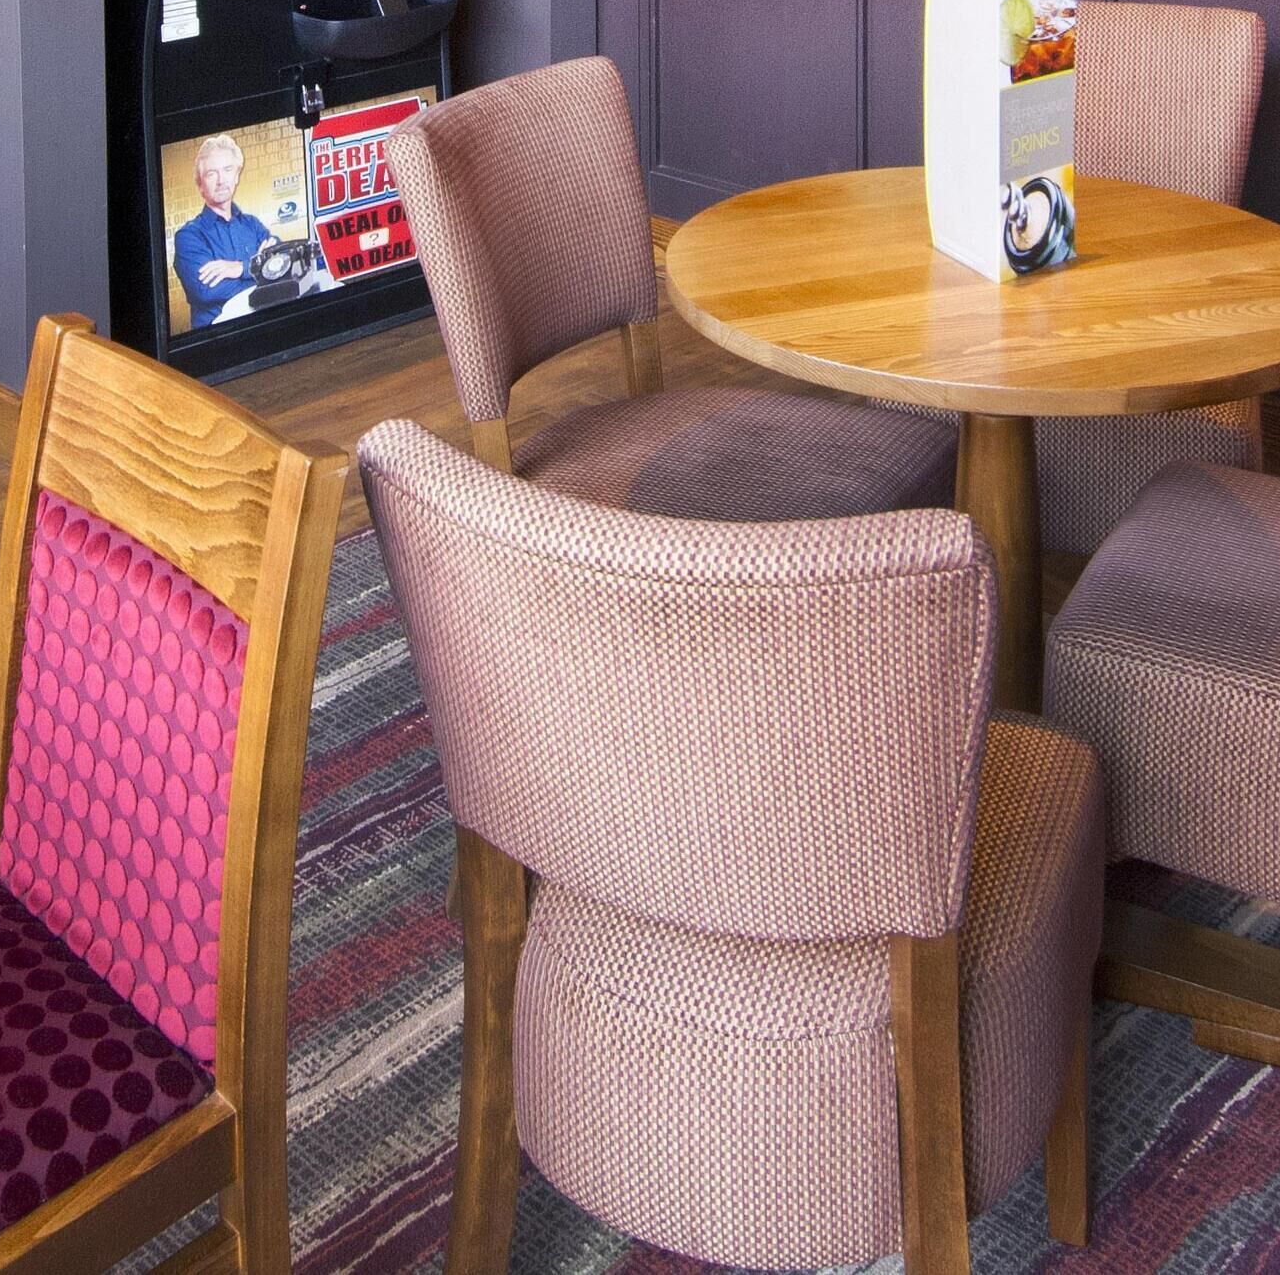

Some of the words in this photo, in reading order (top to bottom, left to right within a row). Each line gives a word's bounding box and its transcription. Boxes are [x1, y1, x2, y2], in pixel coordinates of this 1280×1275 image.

[315, 142, 330, 154] THE
[1010, 126, 1061, 158] DRINKS
[316, 161, 399, 209] DEA
[327, 209, 384, 241] DEAL
[336, 253, 365, 275] NO
[370, 238, 412, 266] DEAL
